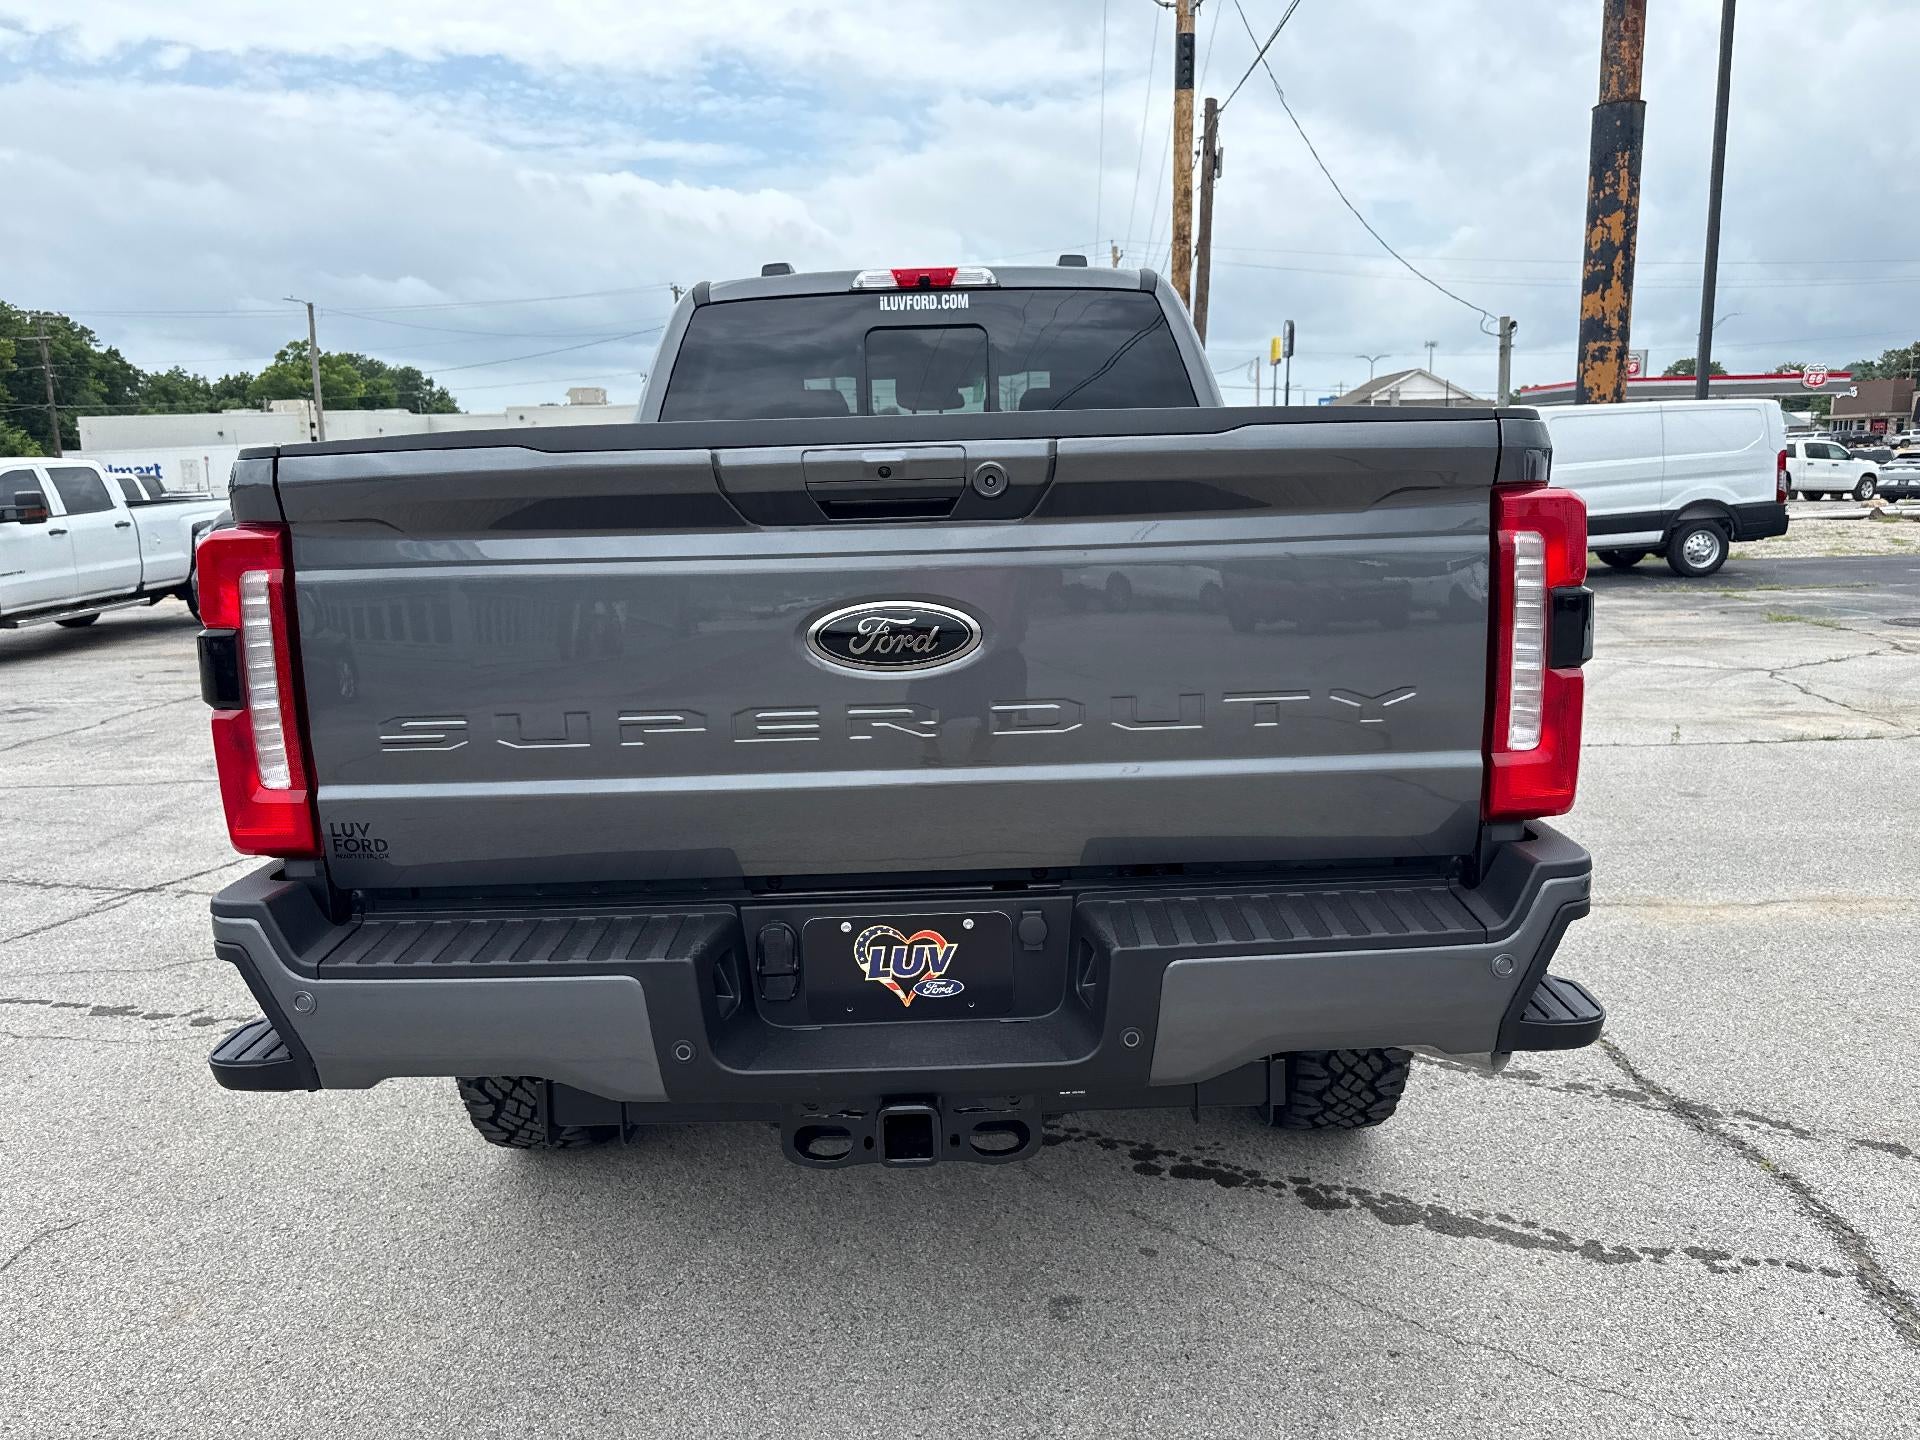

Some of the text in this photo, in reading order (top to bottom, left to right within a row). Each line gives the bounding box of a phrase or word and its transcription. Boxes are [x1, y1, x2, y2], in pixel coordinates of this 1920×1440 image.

[1808, 374, 1824, 384] 66
[848, 616, 940, 655] Ford
[330, 823, 371, 837] LUV
[333, 838, 388, 852] FORD
[865, 943, 959, 981] LUV
[922, 981, 955, 995] Ford
